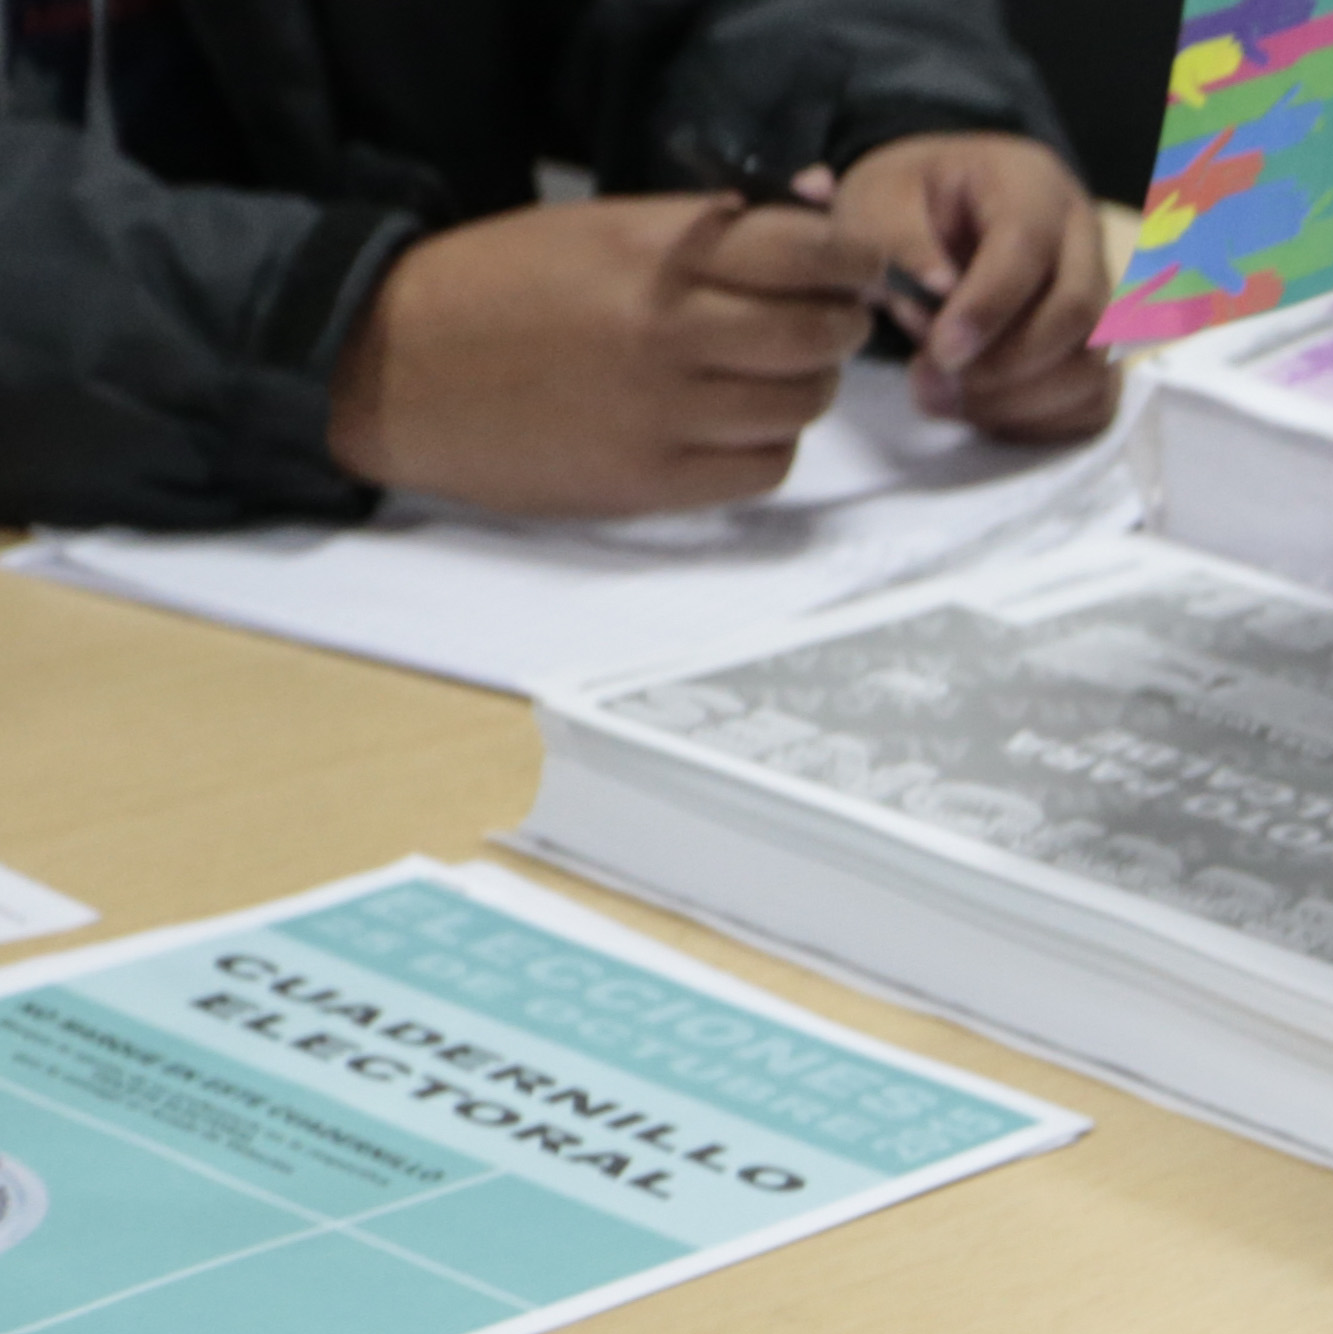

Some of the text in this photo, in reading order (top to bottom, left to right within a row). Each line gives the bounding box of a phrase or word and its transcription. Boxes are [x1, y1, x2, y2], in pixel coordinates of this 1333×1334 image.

[190, 988, 678, 1202] ELECTORAL
[213, 950, 808, 1195] CUADERNILLO
[360, 886, 940, 1120] ELECCIONES
[408, 948, 517, 1002] DE
[521, 993, 884, 1147] OCTUBRE
